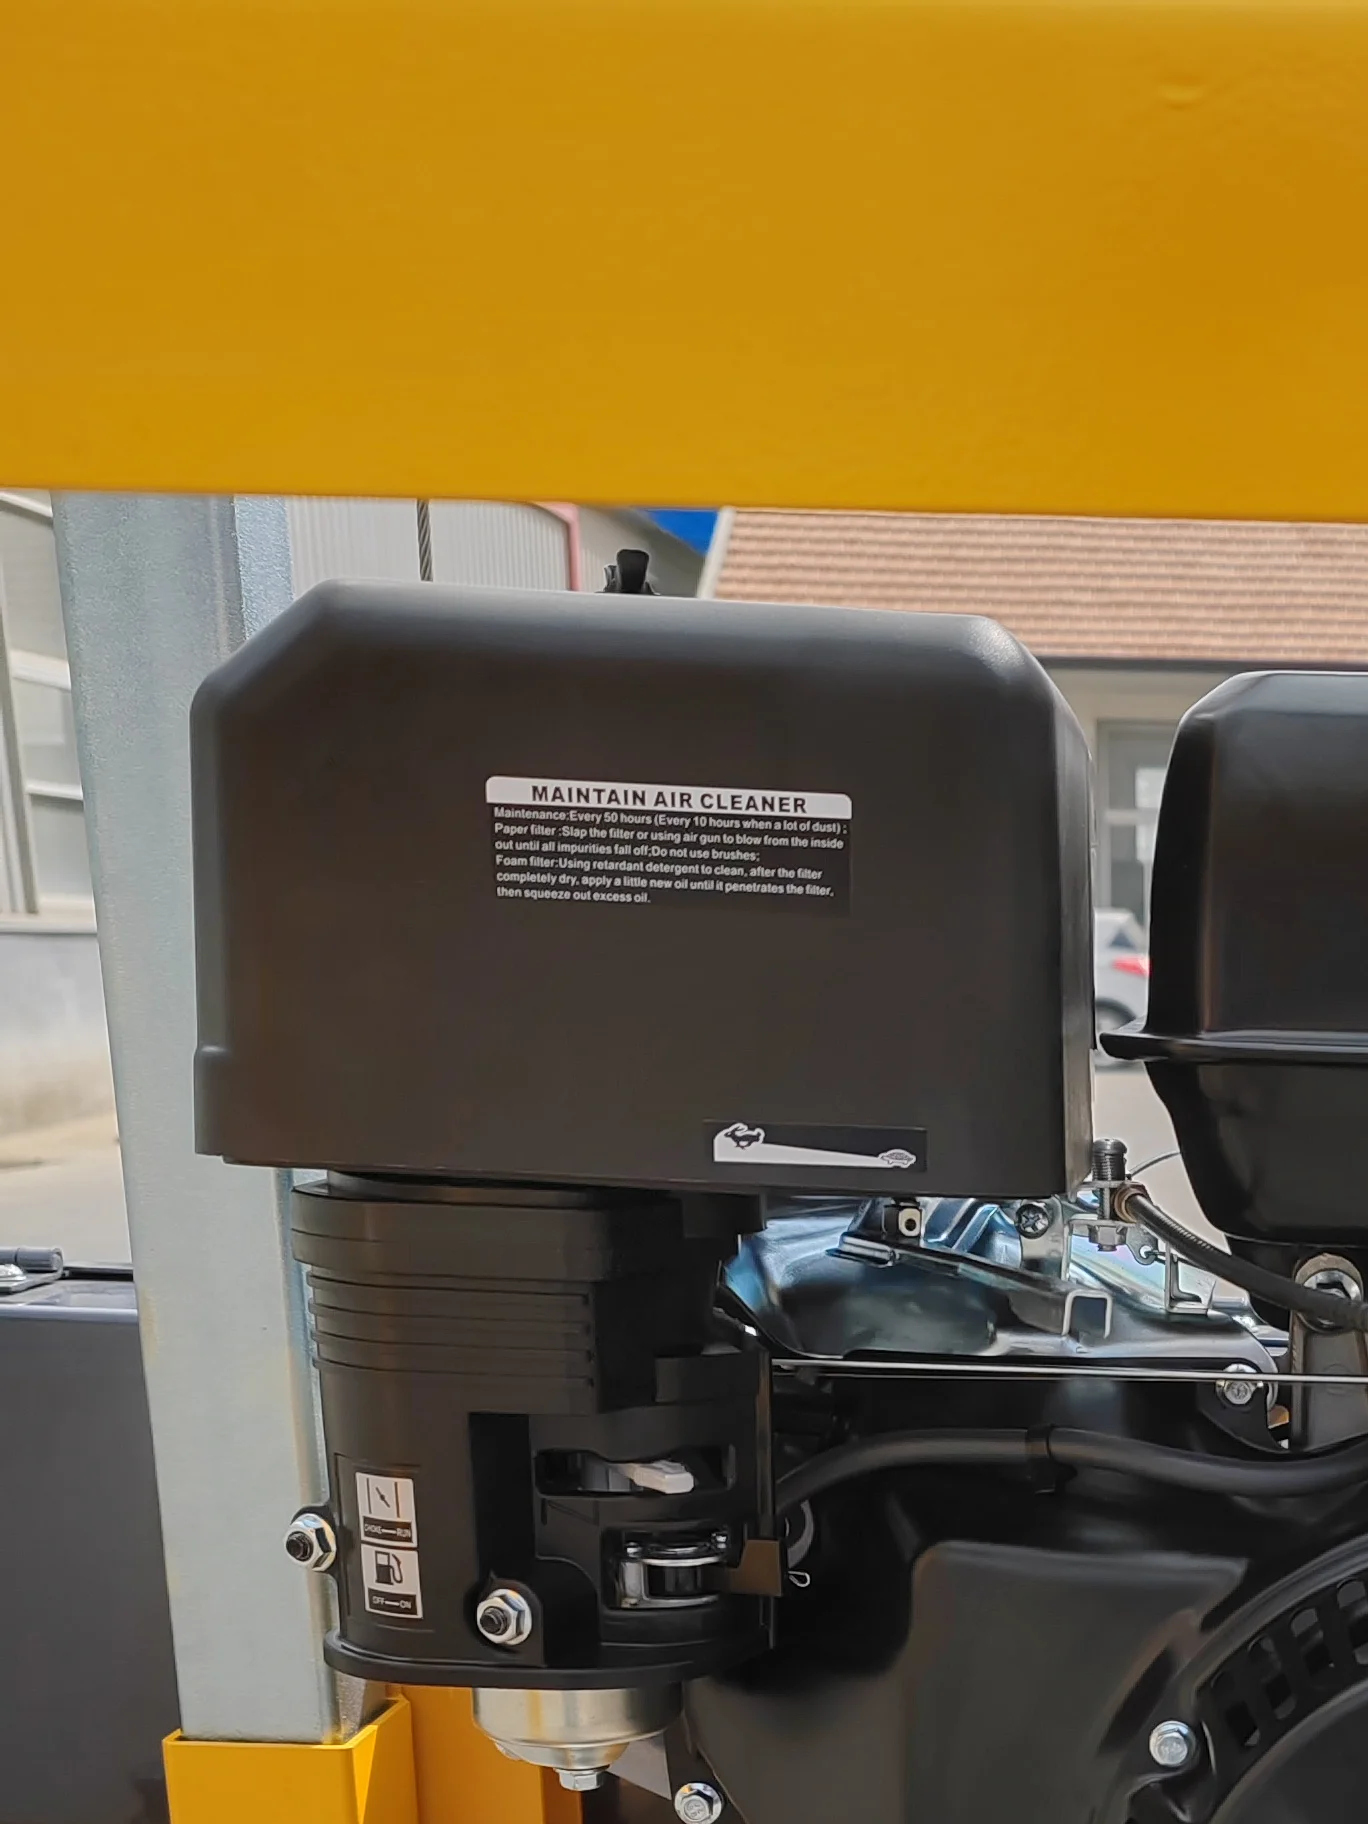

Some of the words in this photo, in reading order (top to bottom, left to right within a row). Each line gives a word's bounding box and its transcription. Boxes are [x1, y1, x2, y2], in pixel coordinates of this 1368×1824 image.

[531, 785, 646, 806] MAINTAIN
[653, 791, 693, 808] AIR
[700, 793, 807, 814] CLEANER
[604, 811, 618, 823] 50
[620, 813, 652, 825] hours
[654, 813, 691, 828] (Every
[694, 816, 707, 827] 10
[709, 817, 740, 829] hours
[742, 818, 772, 830] when
[774, 821, 781, 831] a
[783, 820, 797, 831] lot
[799, 820, 810, 832] of
[495, 822, 528, 836] Paper
[530, 824, 556, 836] filter
[589, 827, 607, 839] the
[609, 827, 635, 840] filter
[637, 831, 648, 840] or
[651, 831, 681, 844] using
[683, 832, 698, 842] air
[699, 834, 721, 845] gun
[723, 833, 734, 844] to
[736, 834, 762, 845] blow
[764, 834, 789, 846] from
[791, 836, 808, 848] the
[811, 837, 843, 849] inside
[495, 840, 513, 850] out
[515, 840, 539, 851] until
[541, 840, 555, 852] all
[557, 842, 612, 855] impurities
[614, 843, 631, 856] fall
[669, 847, 687, 857] not
[689, 849, 709, 859] use
[496, 854, 527, 866] Foam
[593, 860, 644, 872] retardant
[645, 862, 699, 876] detergent
[701, 864, 712, 875] to
[750, 866, 776, 877] after
[778, 868, 795, 878] the
[797, 868, 822, 879] filter
[497, 871, 557, 886] completely
[581, 875, 612, 888] apply
[614, 877, 621, 887] a
[623, 876, 647, 888] little
[649, 879, 672, 889] new
[674, 878, 688, 889] oil
[690, 879, 714, 891] until
[716, 880, 723, 891] it
[725, 882, 784, 894] penetrates
[786, 883, 804, 895] the
[497, 886, 522, 898] then
[524, 889, 571, 900] squeeze
[573, 890, 591, 901] out
[593, 891, 632, 903] excess
